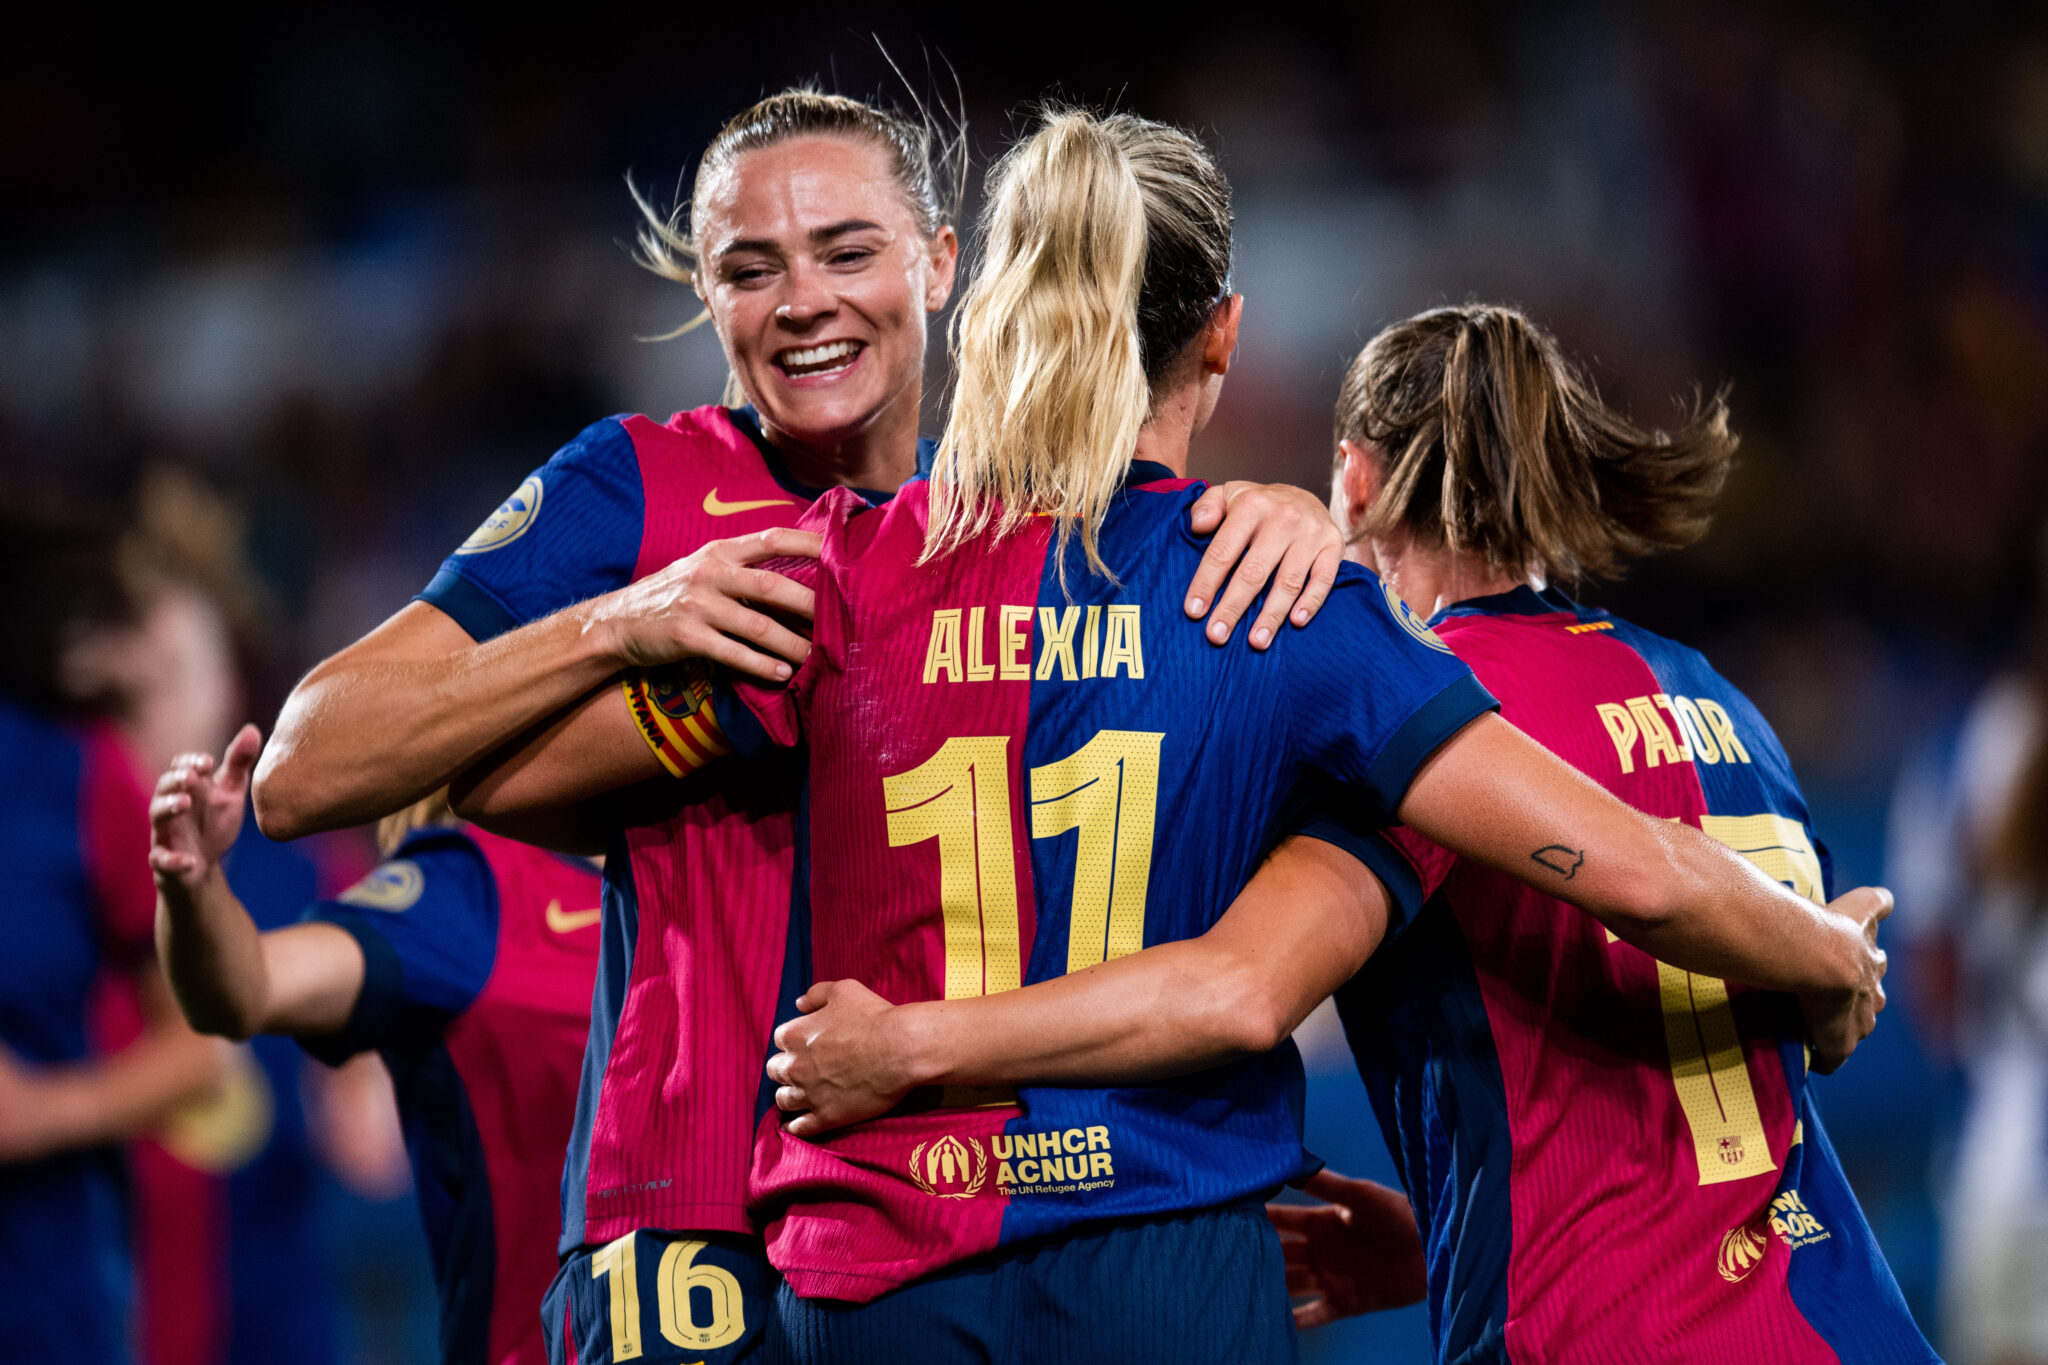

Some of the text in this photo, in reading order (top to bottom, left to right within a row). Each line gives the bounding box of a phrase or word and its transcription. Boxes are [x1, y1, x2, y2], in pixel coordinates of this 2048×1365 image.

[922, 604, 1144, 684] ALEXIA
[1595, 693, 1751, 774] PAJOR
[883, 730, 1166, 1001] 11
[991, 1125, 1112, 1160] UNHCR
[995, 1152, 1114, 1186] ACNUR
[997, 1179, 1115, 1196] The UN Refugee Agency
[591, 1231, 746, 1363] 16
